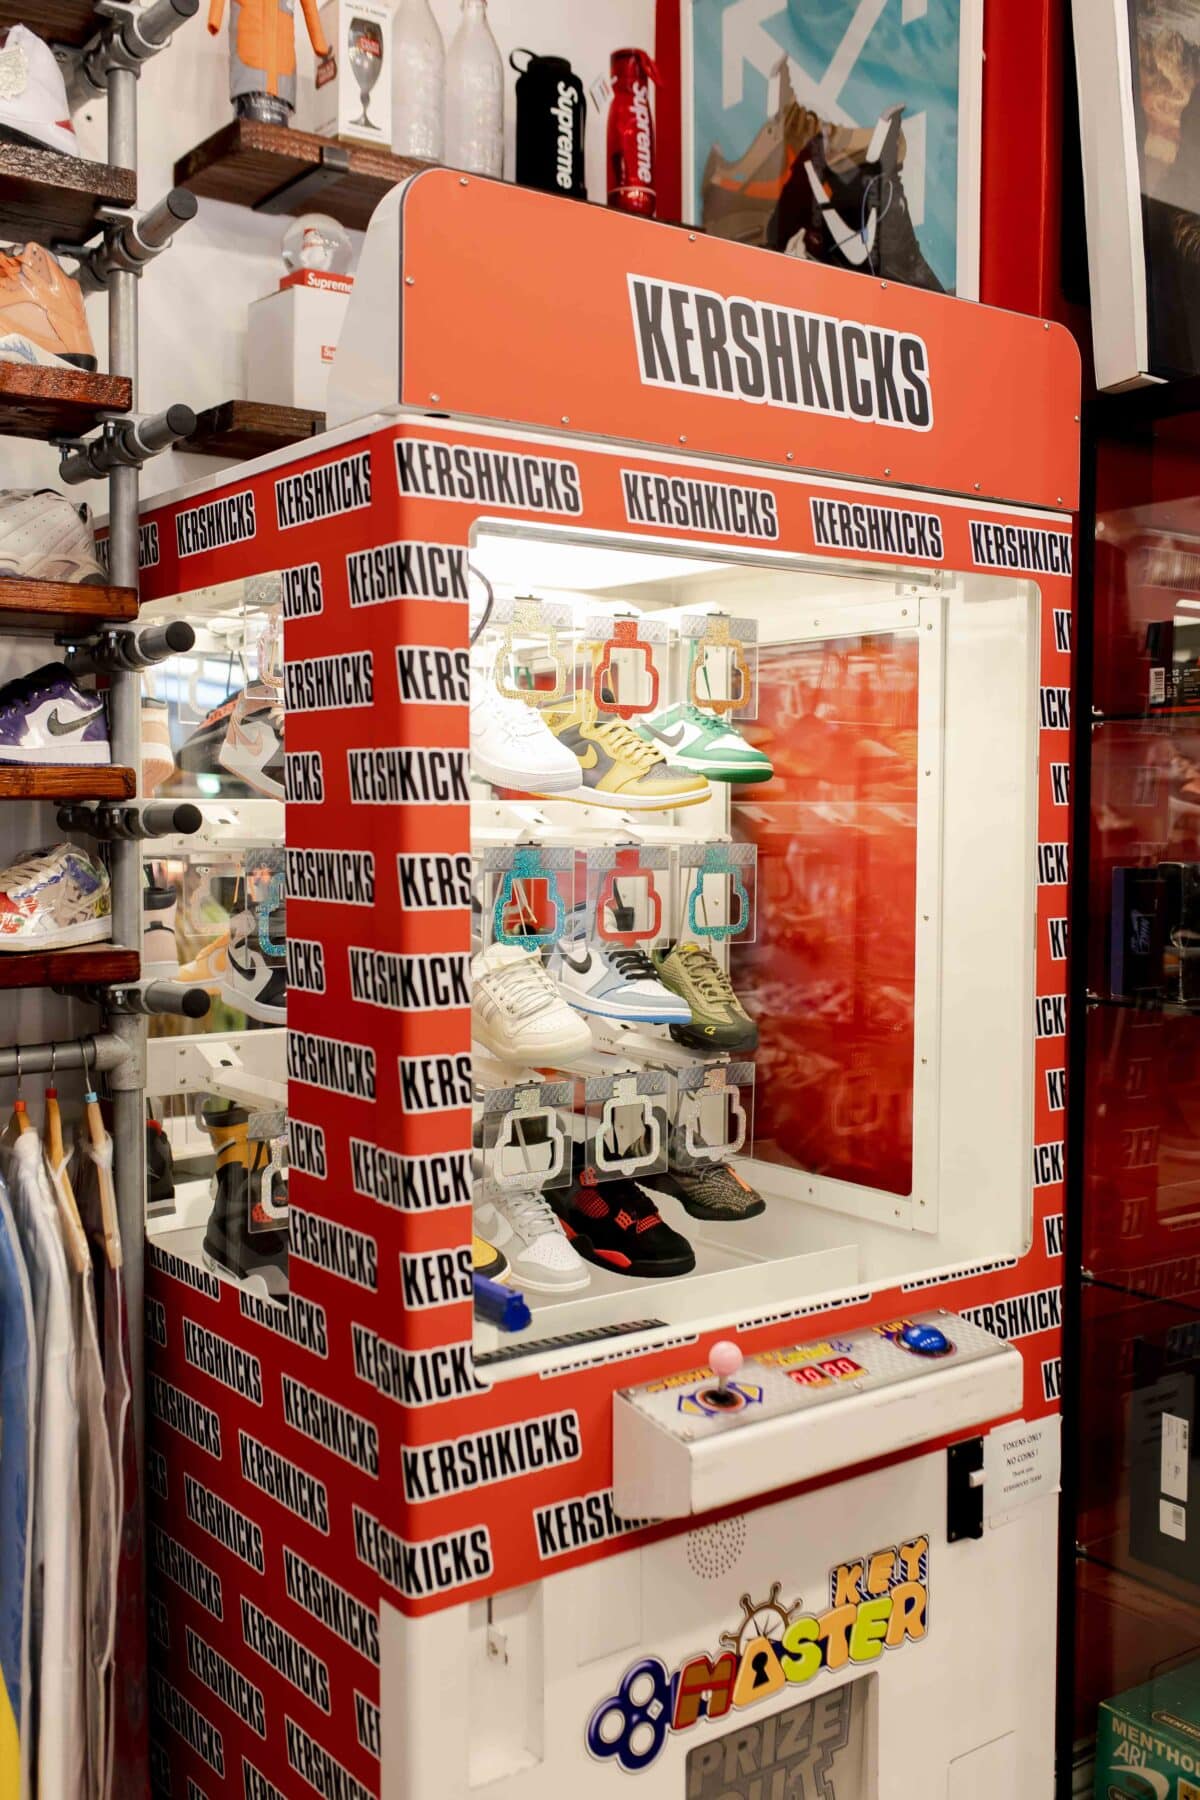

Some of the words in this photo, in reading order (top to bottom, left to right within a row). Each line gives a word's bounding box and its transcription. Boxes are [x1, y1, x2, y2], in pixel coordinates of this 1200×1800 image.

[550, 80, 579, 190] Supreme
[629, 82, 651, 184] Supreme
[633, 280, 931, 428] KERSHKICKS
[277, 454, 371, 528] KERSHKICKS
[399, 440, 578, 513] KERSHKICKS
[623, 473, 777, 539] KERSHKICKS
[177, 493, 255, 557] KERSHKICKS
[811, 500, 943, 560] KERSHKICKS
[971, 521, 1072, 575] KERSHKICK
[283, 564, 322, 618] ICKS
[348, 545, 470, 605] KESHKICK
[399, 647, 470, 700] KERS
[1040, 688, 1070, 728] ICK
[285, 754, 323, 801] ICKS
[350, 751, 470, 802] KESHKICK
[400, 857, 471, 907] KERS
[1038, 844, 1068, 884] ICK
[286, 940, 325, 993] ICKS
[350, 949, 471, 1006] KESHKICK
[1035, 996, 1065, 1035] ICK
[402, 1056, 472, 1110] KERS
[288, 1121, 325, 1178] ICKS
[352, 1141, 472, 1208] KESHKICK
[1034, 1145, 1063, 1184] ICK
[403, 1250, 473, 1308] KERS
[961, 1289, 1063, 1341] RSHKICK
[184, 1319, 262, 1405] KERSHKICKS
[283, 1376, 378, 1478] KERSHKICKS
[402, 1413, 580, 1500] KERSHKICKS
[1002, 1438, 1026, 1452] TOKENS
[1027, 1432, 1042, 1444] ONLY
[240, 1433, 328, 1535] KERSHKICKS
[1007, 1456, 1016, 1466] NO
[186, 1475, 263, 1575] KERSHKICKS
[833, 1537, 930, 1607] KEY
[284, 1547, 379, 1667] KERSHKICKS
[187, 1628, 265, 1740] KERSHKICKS
[241, 1597, 330, 1715] KERSHKICKS
[671, 1581, 929, 1731] MASTER
[688, 1684, 845, 1798] PRIZE
